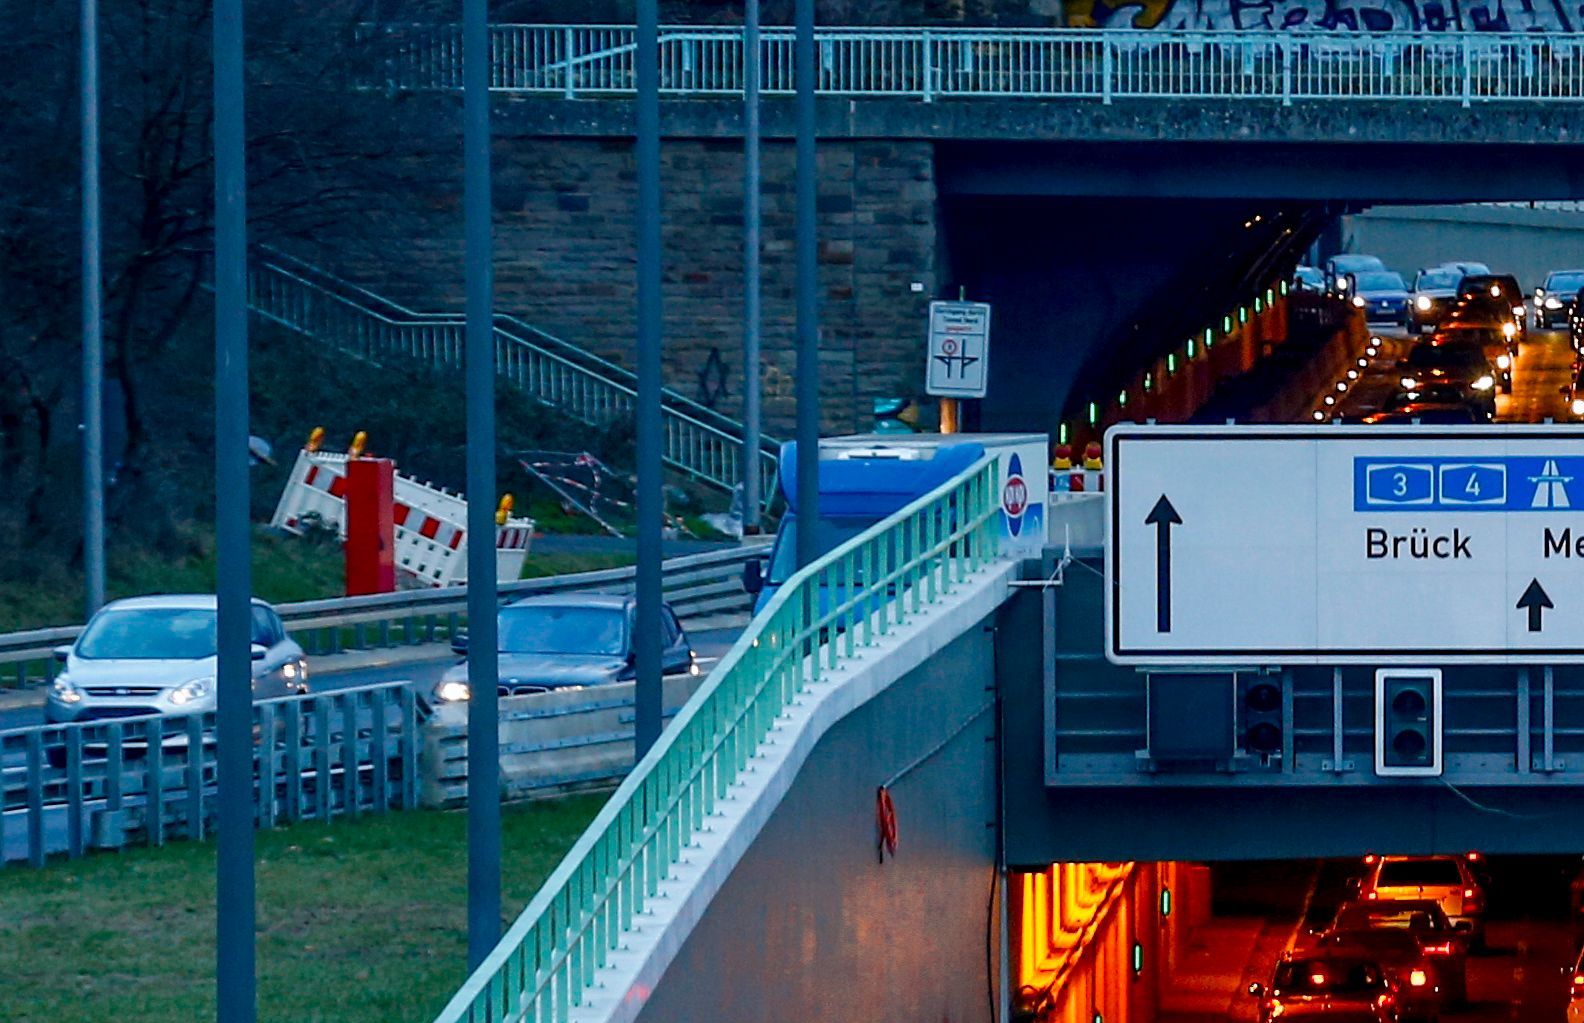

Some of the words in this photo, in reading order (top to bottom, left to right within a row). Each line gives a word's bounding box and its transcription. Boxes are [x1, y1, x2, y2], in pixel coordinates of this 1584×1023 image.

[1393, 472, 1408, 497] 3
[1465, 472, 1481, 497] 4
[1366, 527, 1473, 559] Brück
